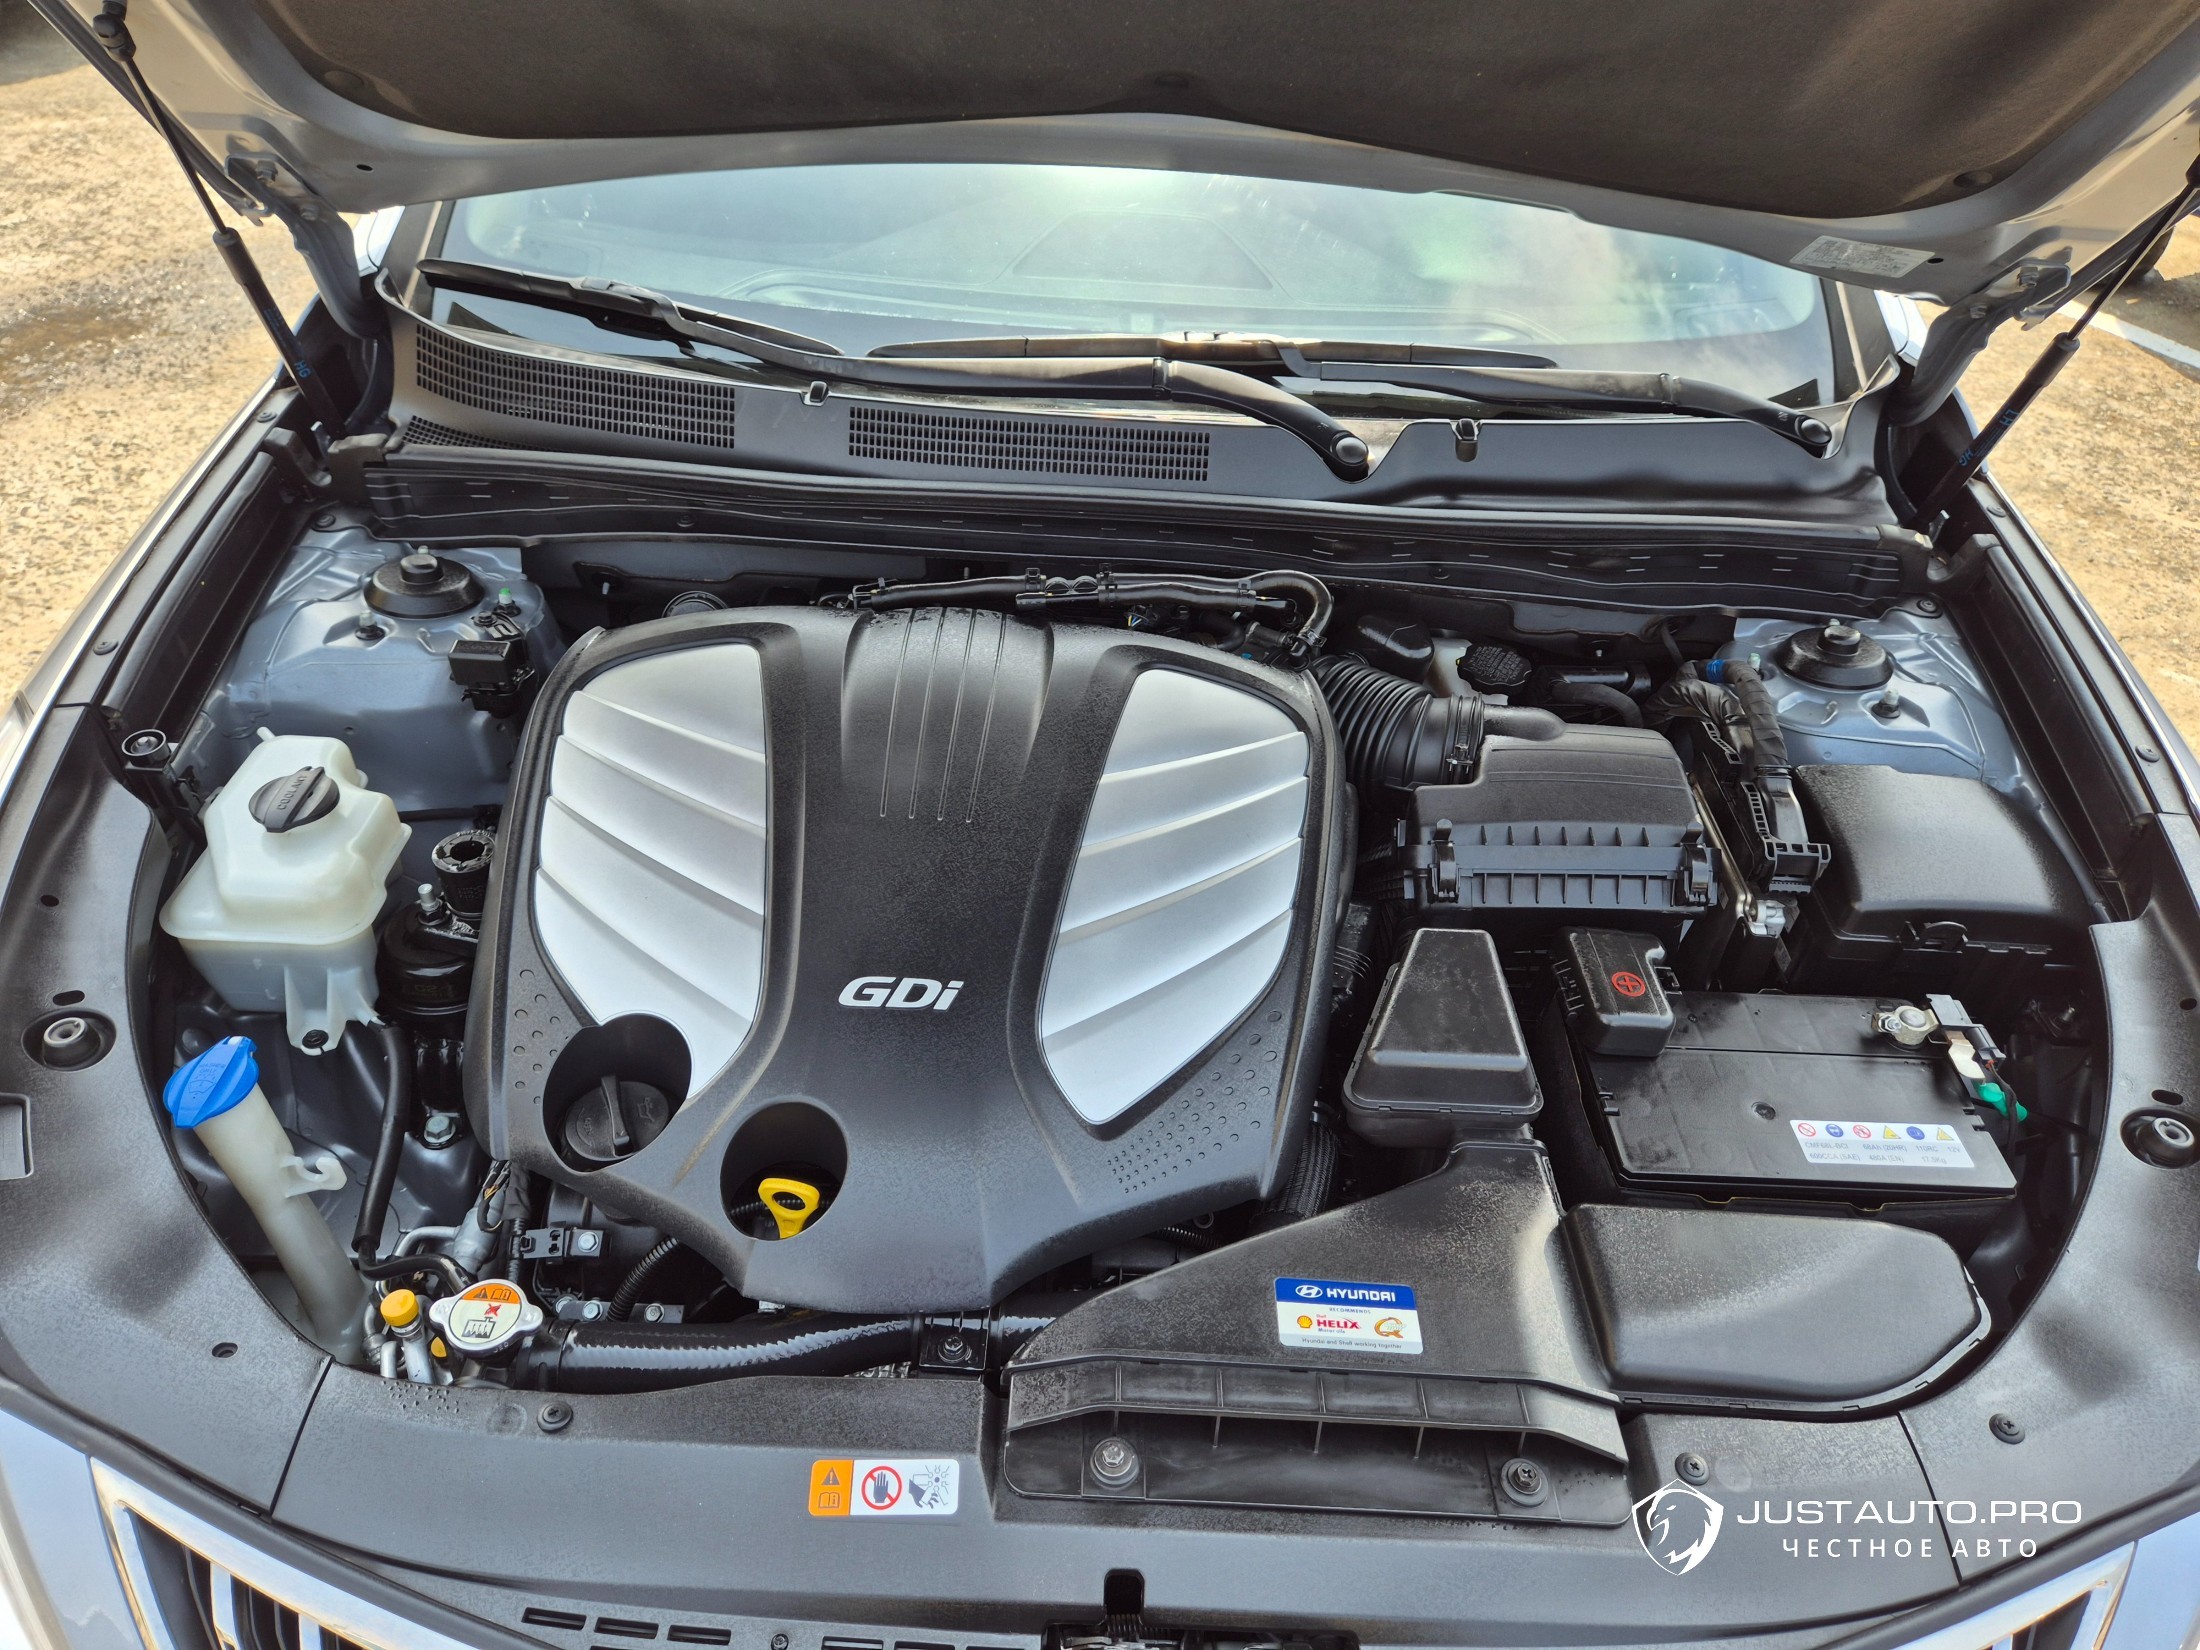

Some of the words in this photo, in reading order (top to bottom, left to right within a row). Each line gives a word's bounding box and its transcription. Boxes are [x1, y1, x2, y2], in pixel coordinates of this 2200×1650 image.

[294, 360, 312, 378] HG
[277, 776, 307, 810] COOLANT
[838, 976, 964, 1010] GDi
[1326, 1288, 1396, 1302] HYUNDAI
[1316, 1318, 1361, 1329] HELIX
[1302, 1337, 1325, 1345] Hyundai
